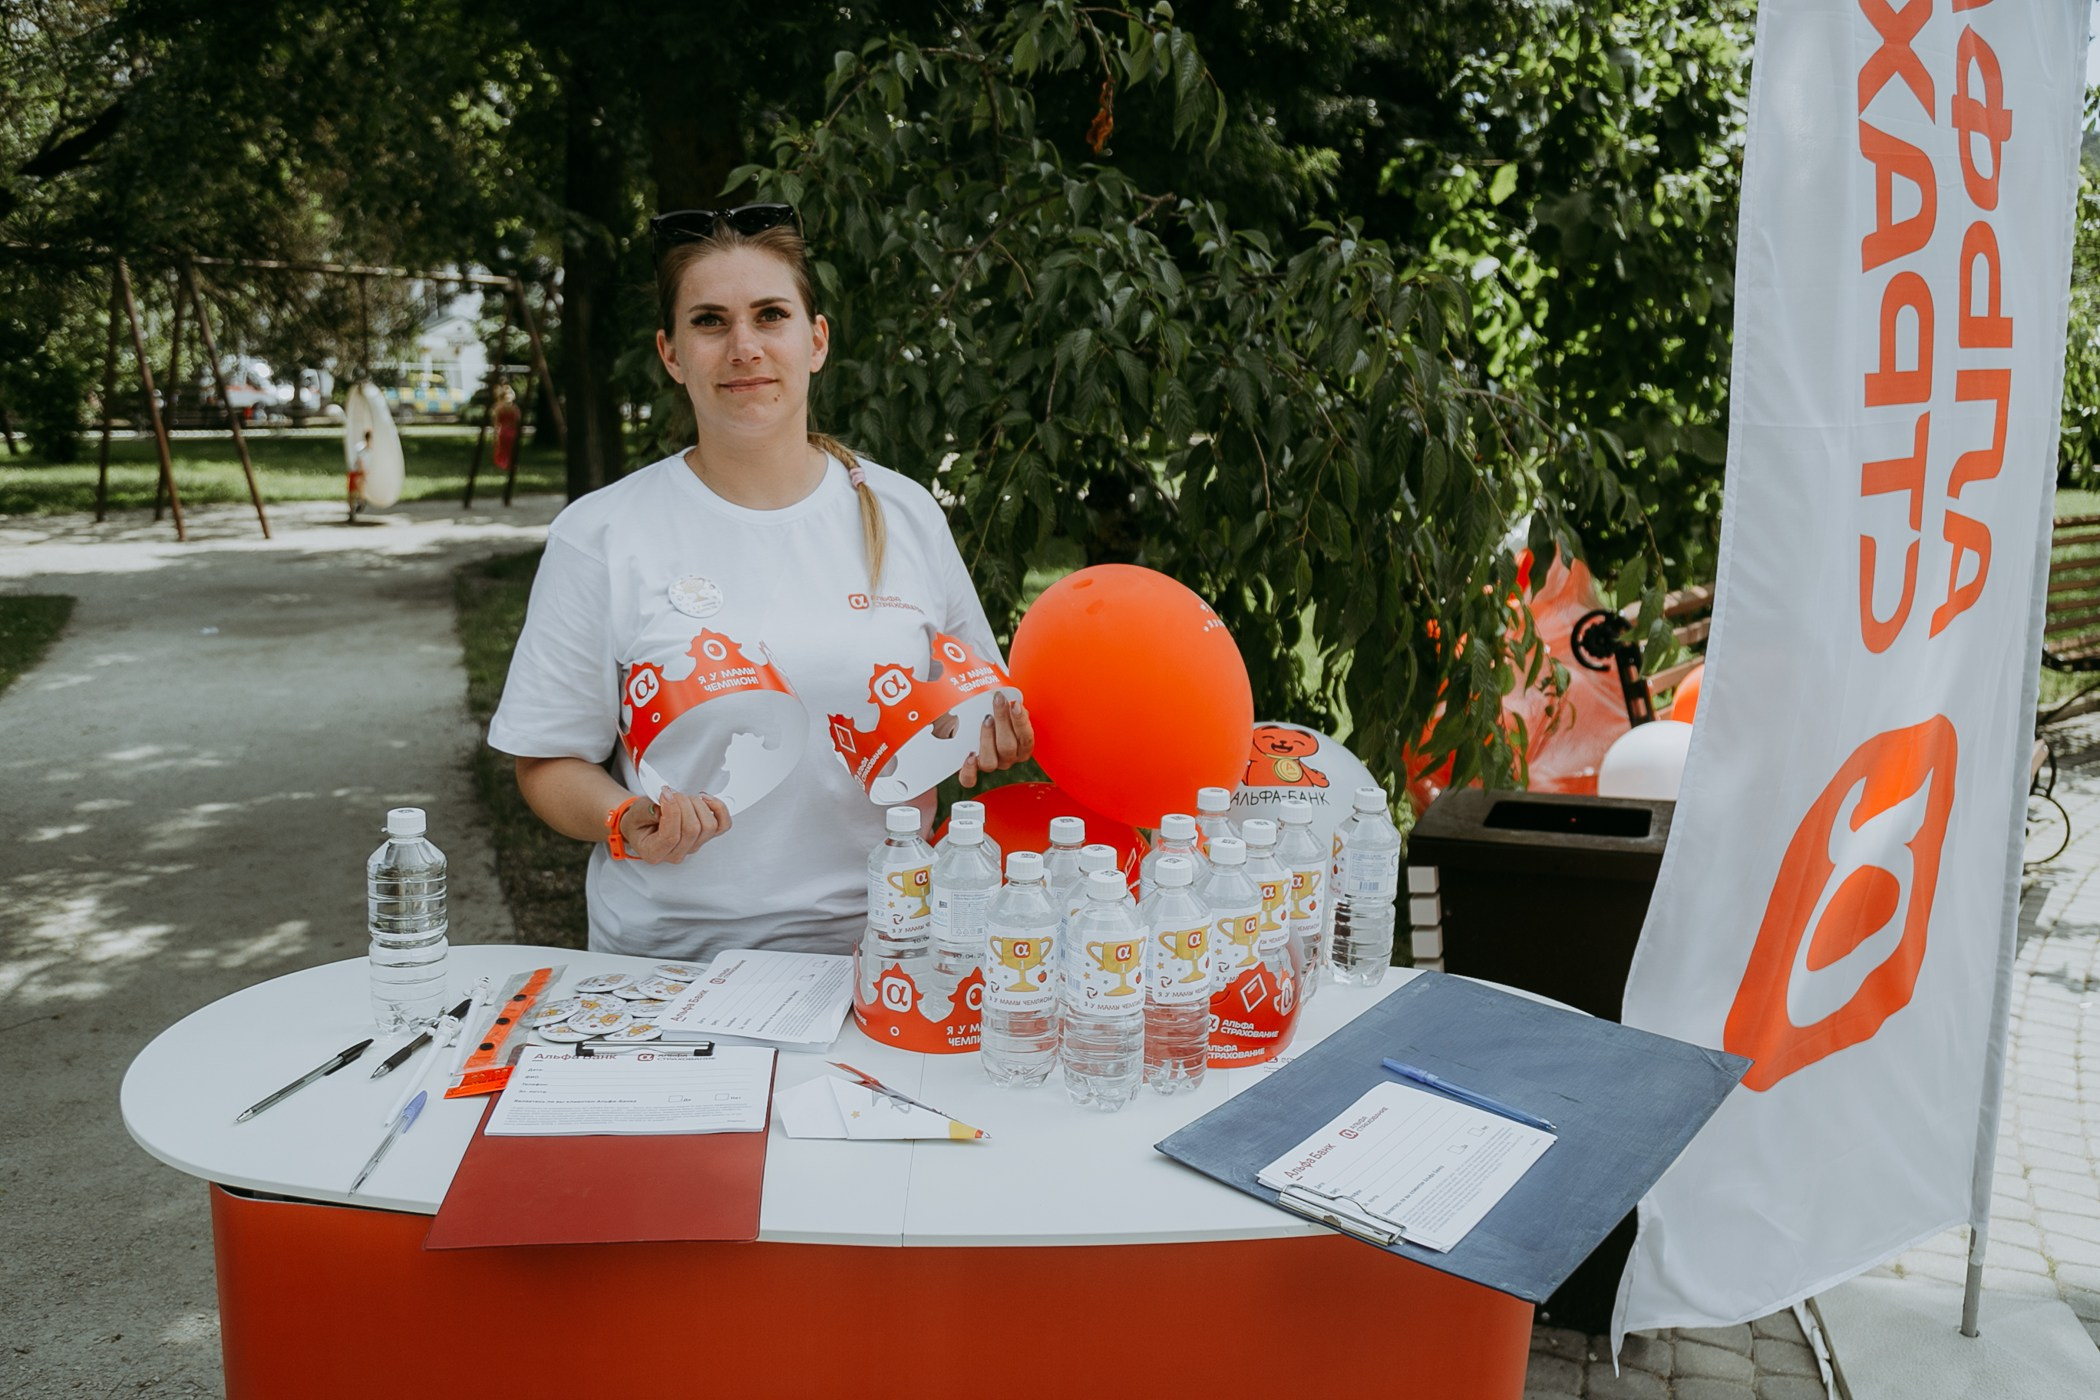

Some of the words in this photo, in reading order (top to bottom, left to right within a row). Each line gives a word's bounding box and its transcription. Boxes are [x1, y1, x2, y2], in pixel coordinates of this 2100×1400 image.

[698, 675, 707, 685] Я
[709, 672, 718, 682] У
[721, 667, 757, 679] МАМЫ
[966, 666, 994, 679] МАМЫ
[703, 676, 760, 693] ЧЕМПИОН!
[1172, 990, 1194, 998] МАМЫ
[1000, 998, 1021, 1006] МАМЫ
[946, 1025, 954, 1036] Я
[957, 1024, 967, 1035] У
[1222, 1018, 1255, 1030] АЛЬФА
[1220, 1026, 1280, 1039] СТРАХОВАНИЕ
[1284, 1154, 1316, 1180] Альфа
[1309, 1143, 1336, 1161] Банк
